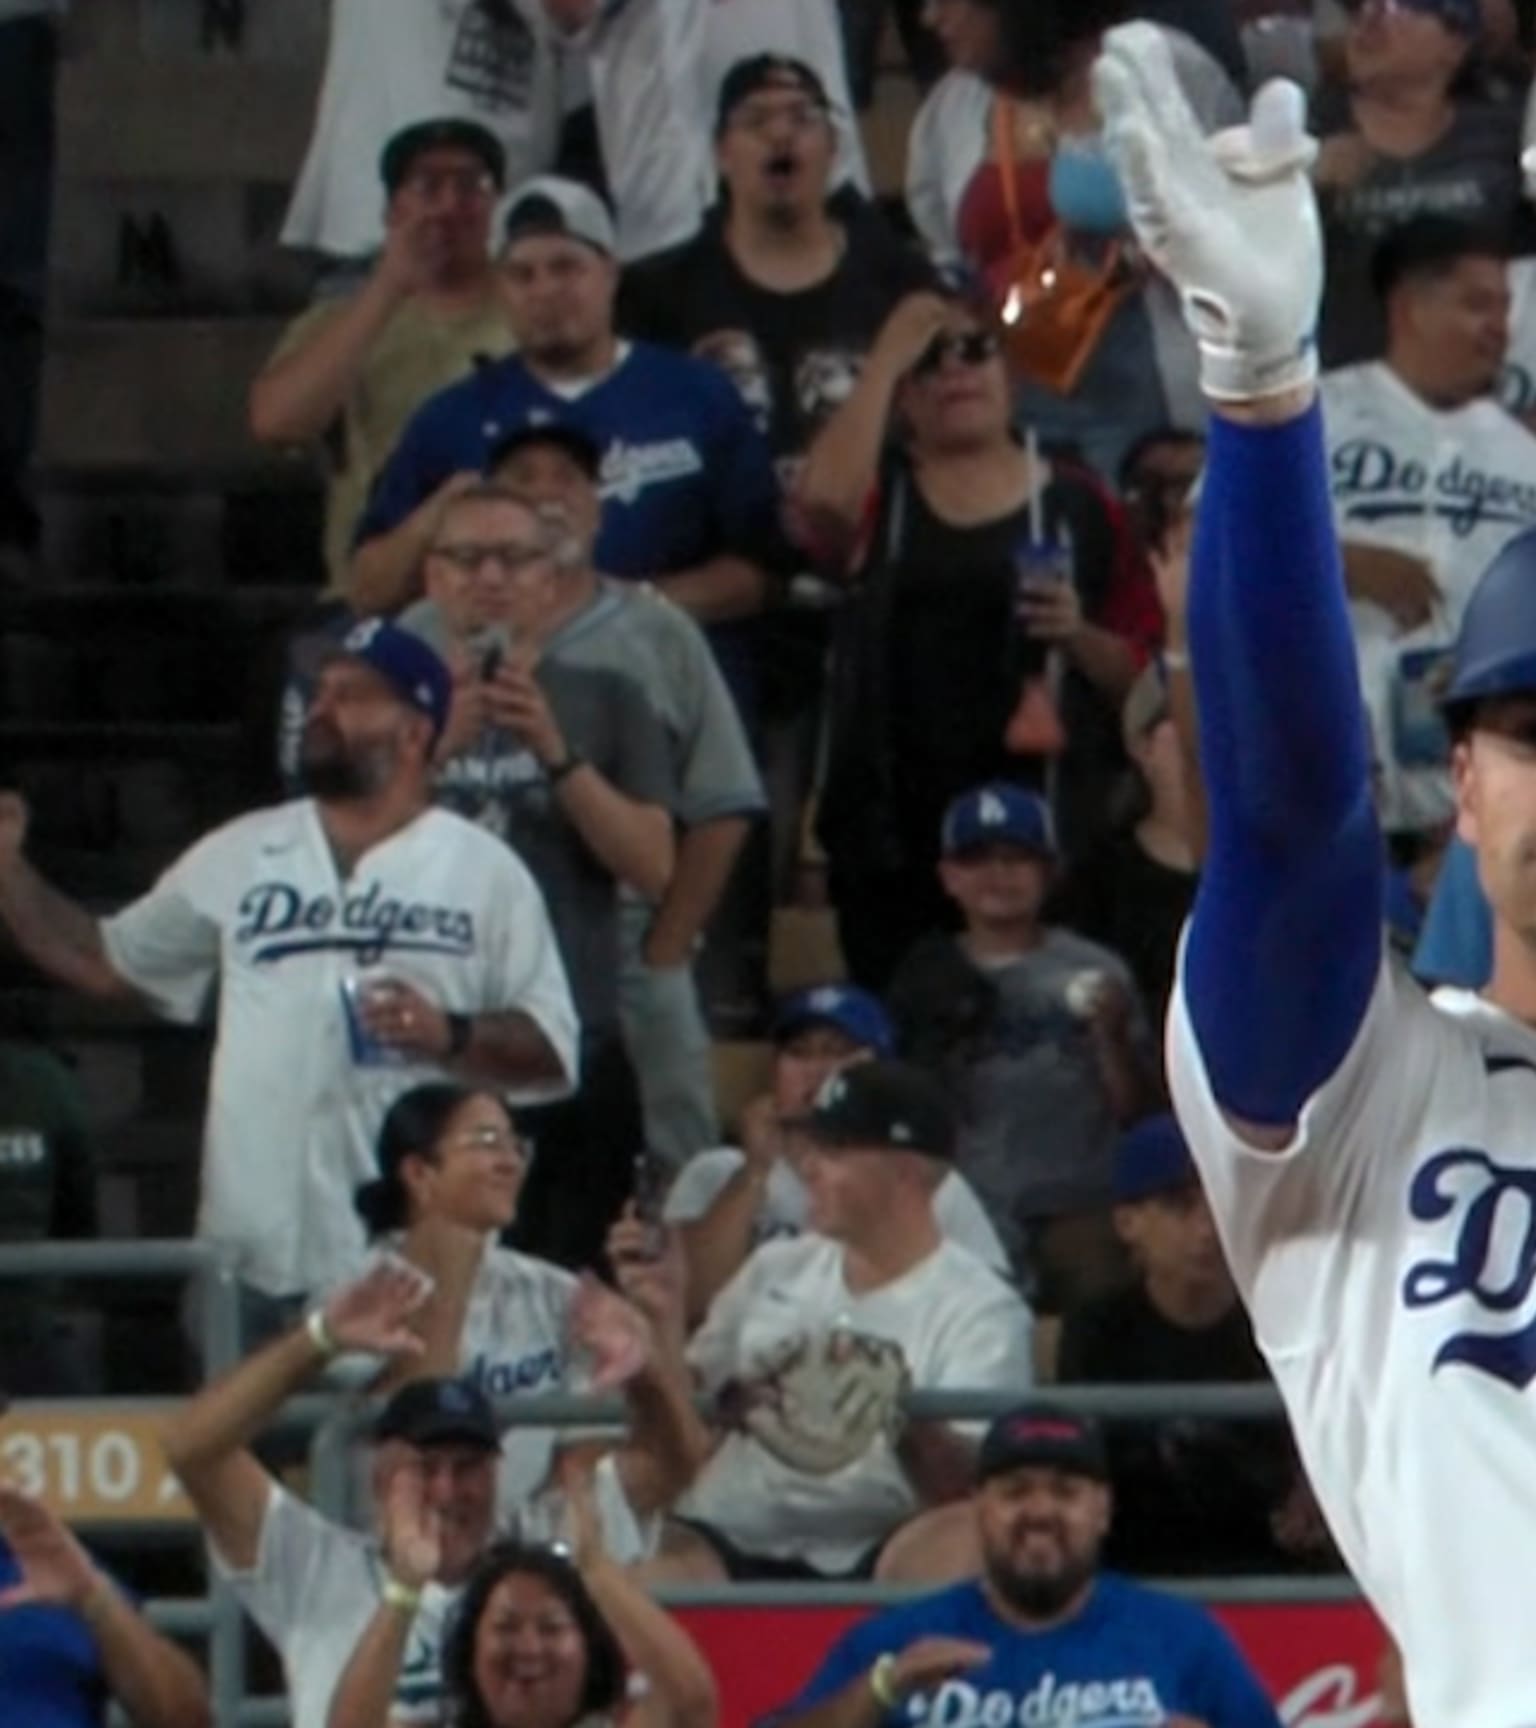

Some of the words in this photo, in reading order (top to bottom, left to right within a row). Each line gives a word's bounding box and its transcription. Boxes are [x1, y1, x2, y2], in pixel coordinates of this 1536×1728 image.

[235, 880, 477, 967] Dodgers
[0, 1431, 139, 1502] 310
[908, 1670, 1166, 1728] Dodgers
